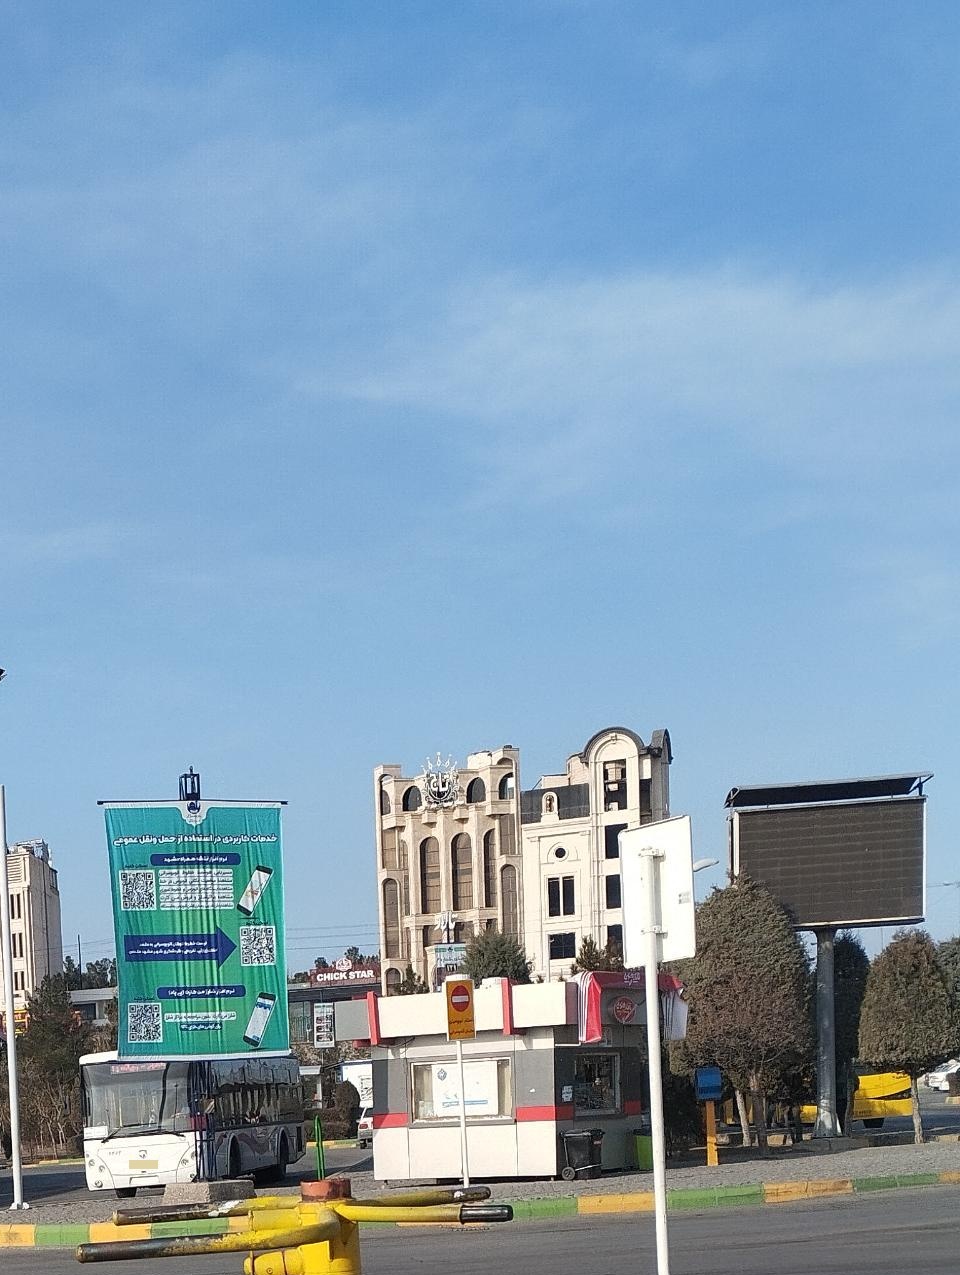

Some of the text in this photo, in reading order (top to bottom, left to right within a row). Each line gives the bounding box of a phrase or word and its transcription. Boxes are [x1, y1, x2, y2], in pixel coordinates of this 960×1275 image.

[113, 836, 138, 846] عمومی
[158, 834, 177, 844] حمل
[184, 833, 213, 843] استفاده
[213, 834, 221, 845] در
[222, 833, 249, 845] کاربردی
[250, 833, 278, 843] خدمات
[316, 969, 375, 982] CHICK STAR
